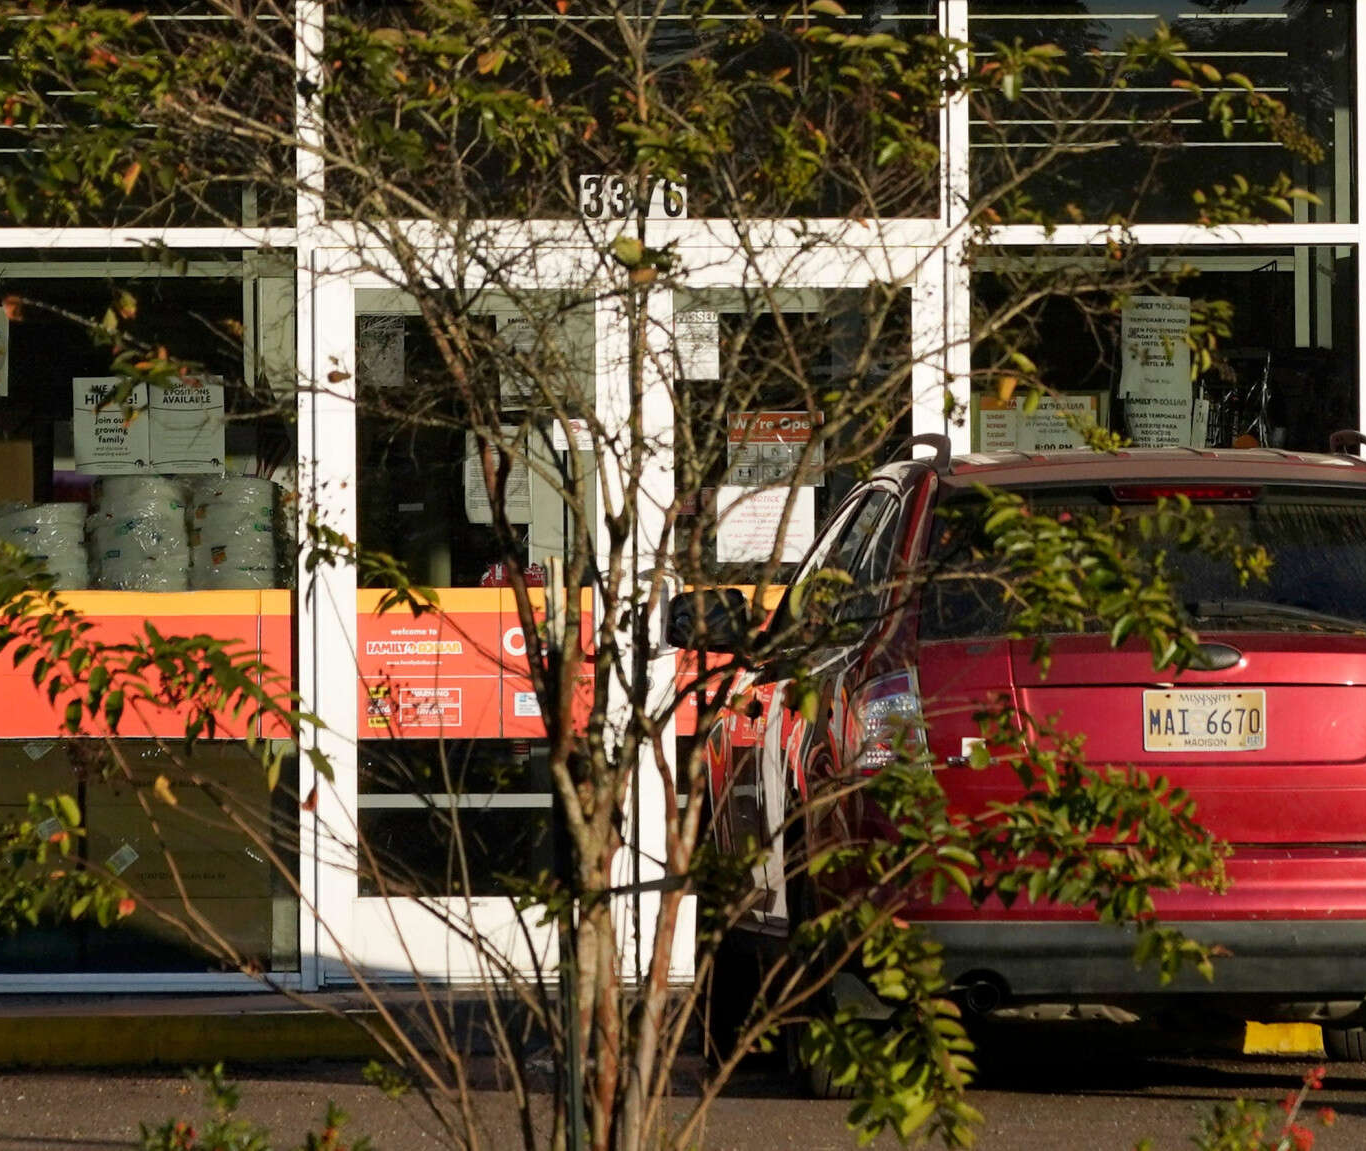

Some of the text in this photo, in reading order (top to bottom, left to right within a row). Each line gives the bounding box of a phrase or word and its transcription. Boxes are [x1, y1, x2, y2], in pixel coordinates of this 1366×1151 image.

[95, 416, 112, 424] Join
[735, 418, 812, 432] W're Ope
[95, 427, 128, 436] growing
[98, 435, 124, 445] family
[367, 642, 407, 654] FAMILY
[1149, 708, 1261, 736] MAI 6670
[1184, 738, 1228, 747] MADISON
